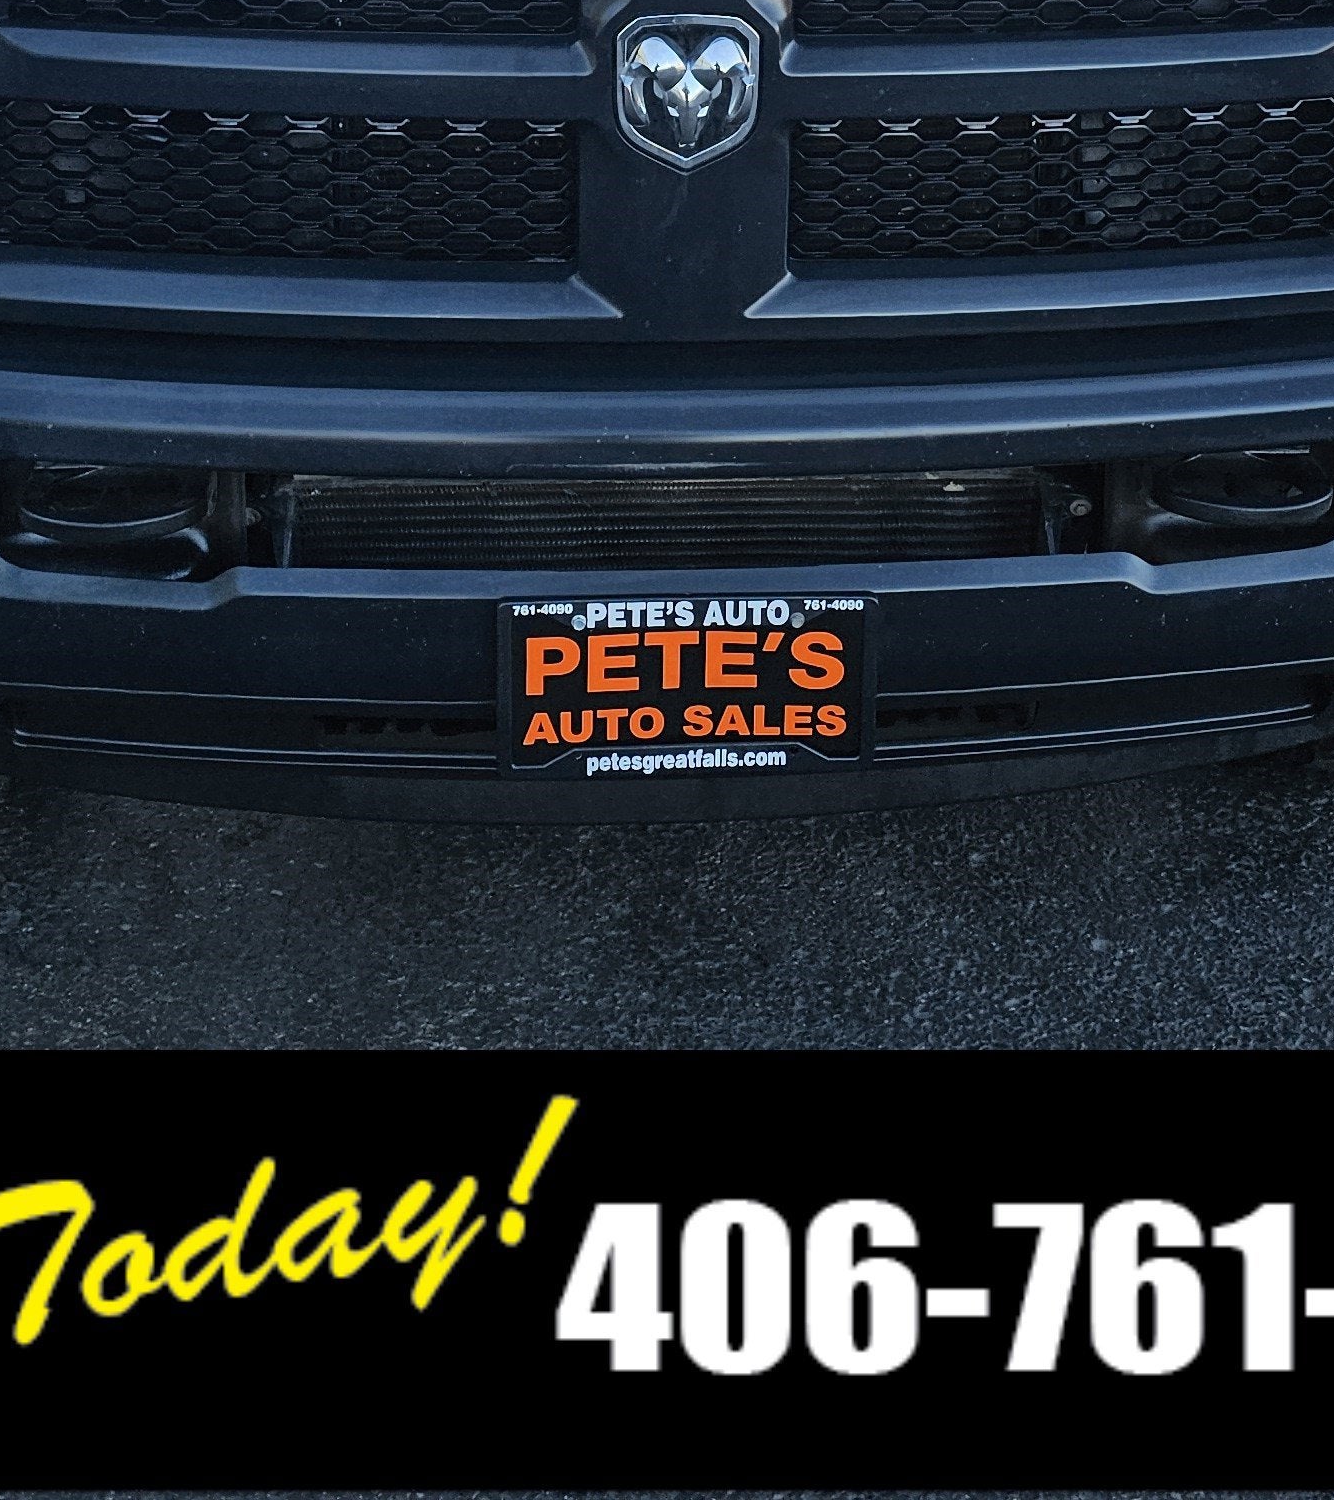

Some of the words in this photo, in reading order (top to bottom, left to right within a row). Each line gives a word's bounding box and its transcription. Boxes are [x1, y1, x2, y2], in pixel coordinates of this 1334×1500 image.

[512, 603, 574, 616] 761-4090
[586, 600, 695, 629] PETE'S
[702, 599, 790, 627] AUTO
[803, 599, 864, 611] 761-4090
[525, 630, 845, 696] PETE'S
[522, 706, 665, 746] AUTO
[683, 704, 847, 738] SALES
[586, 748, 787, 776] petesgreatfalls.com
